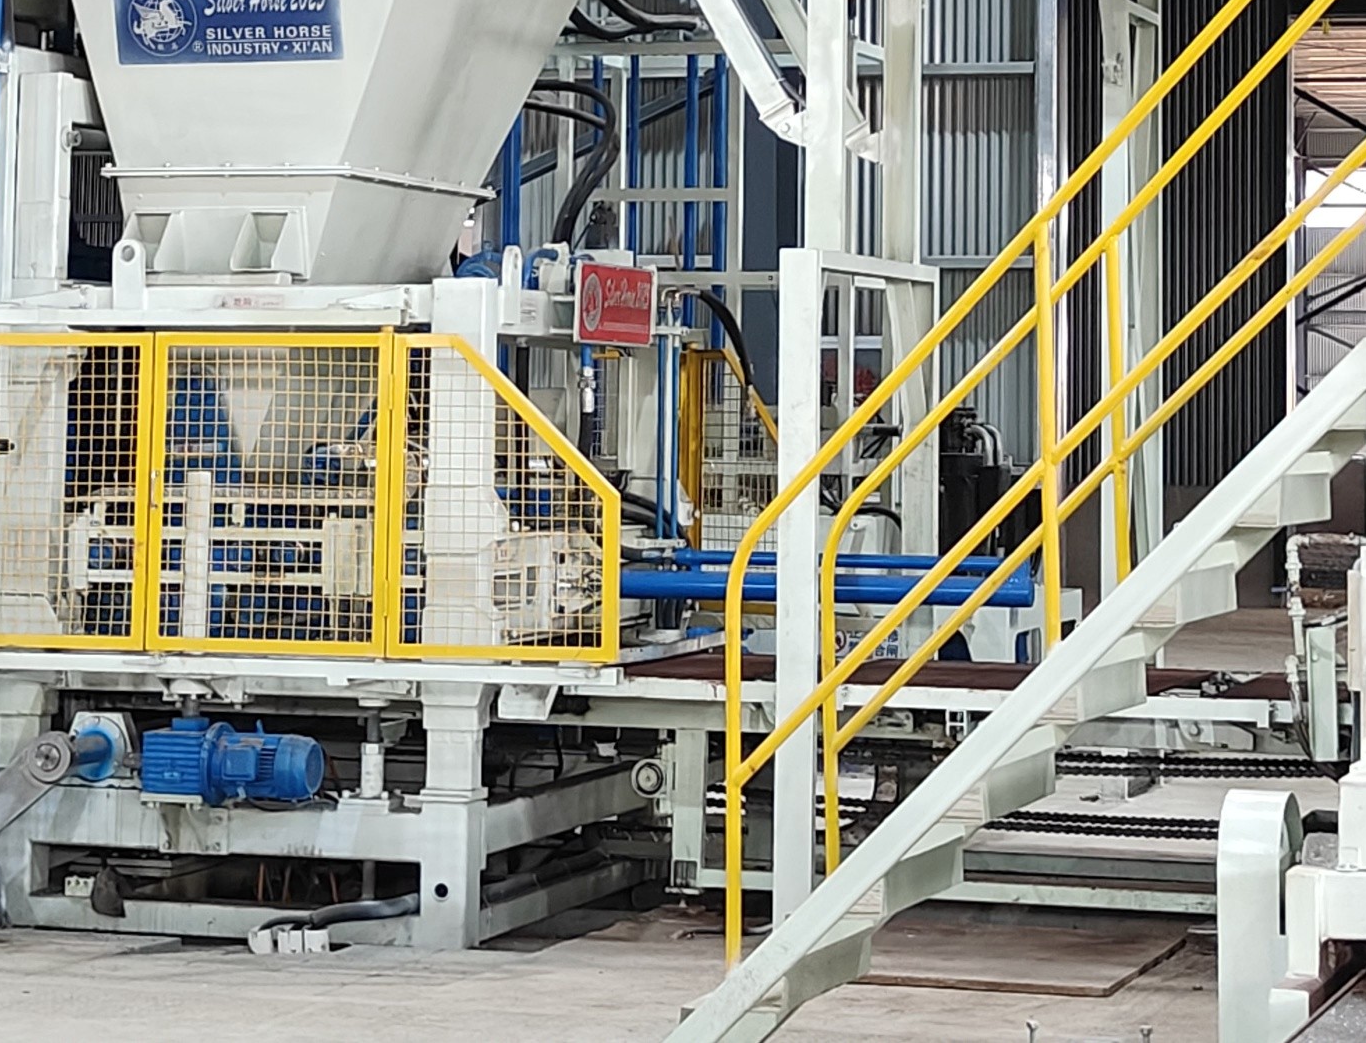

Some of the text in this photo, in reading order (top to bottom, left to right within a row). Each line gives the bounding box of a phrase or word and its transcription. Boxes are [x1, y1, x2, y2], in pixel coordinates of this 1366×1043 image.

[206, 25, 332, 40] SILVER HORSE
[206, 40, 333, 55] INDUSTRY XI'AN
